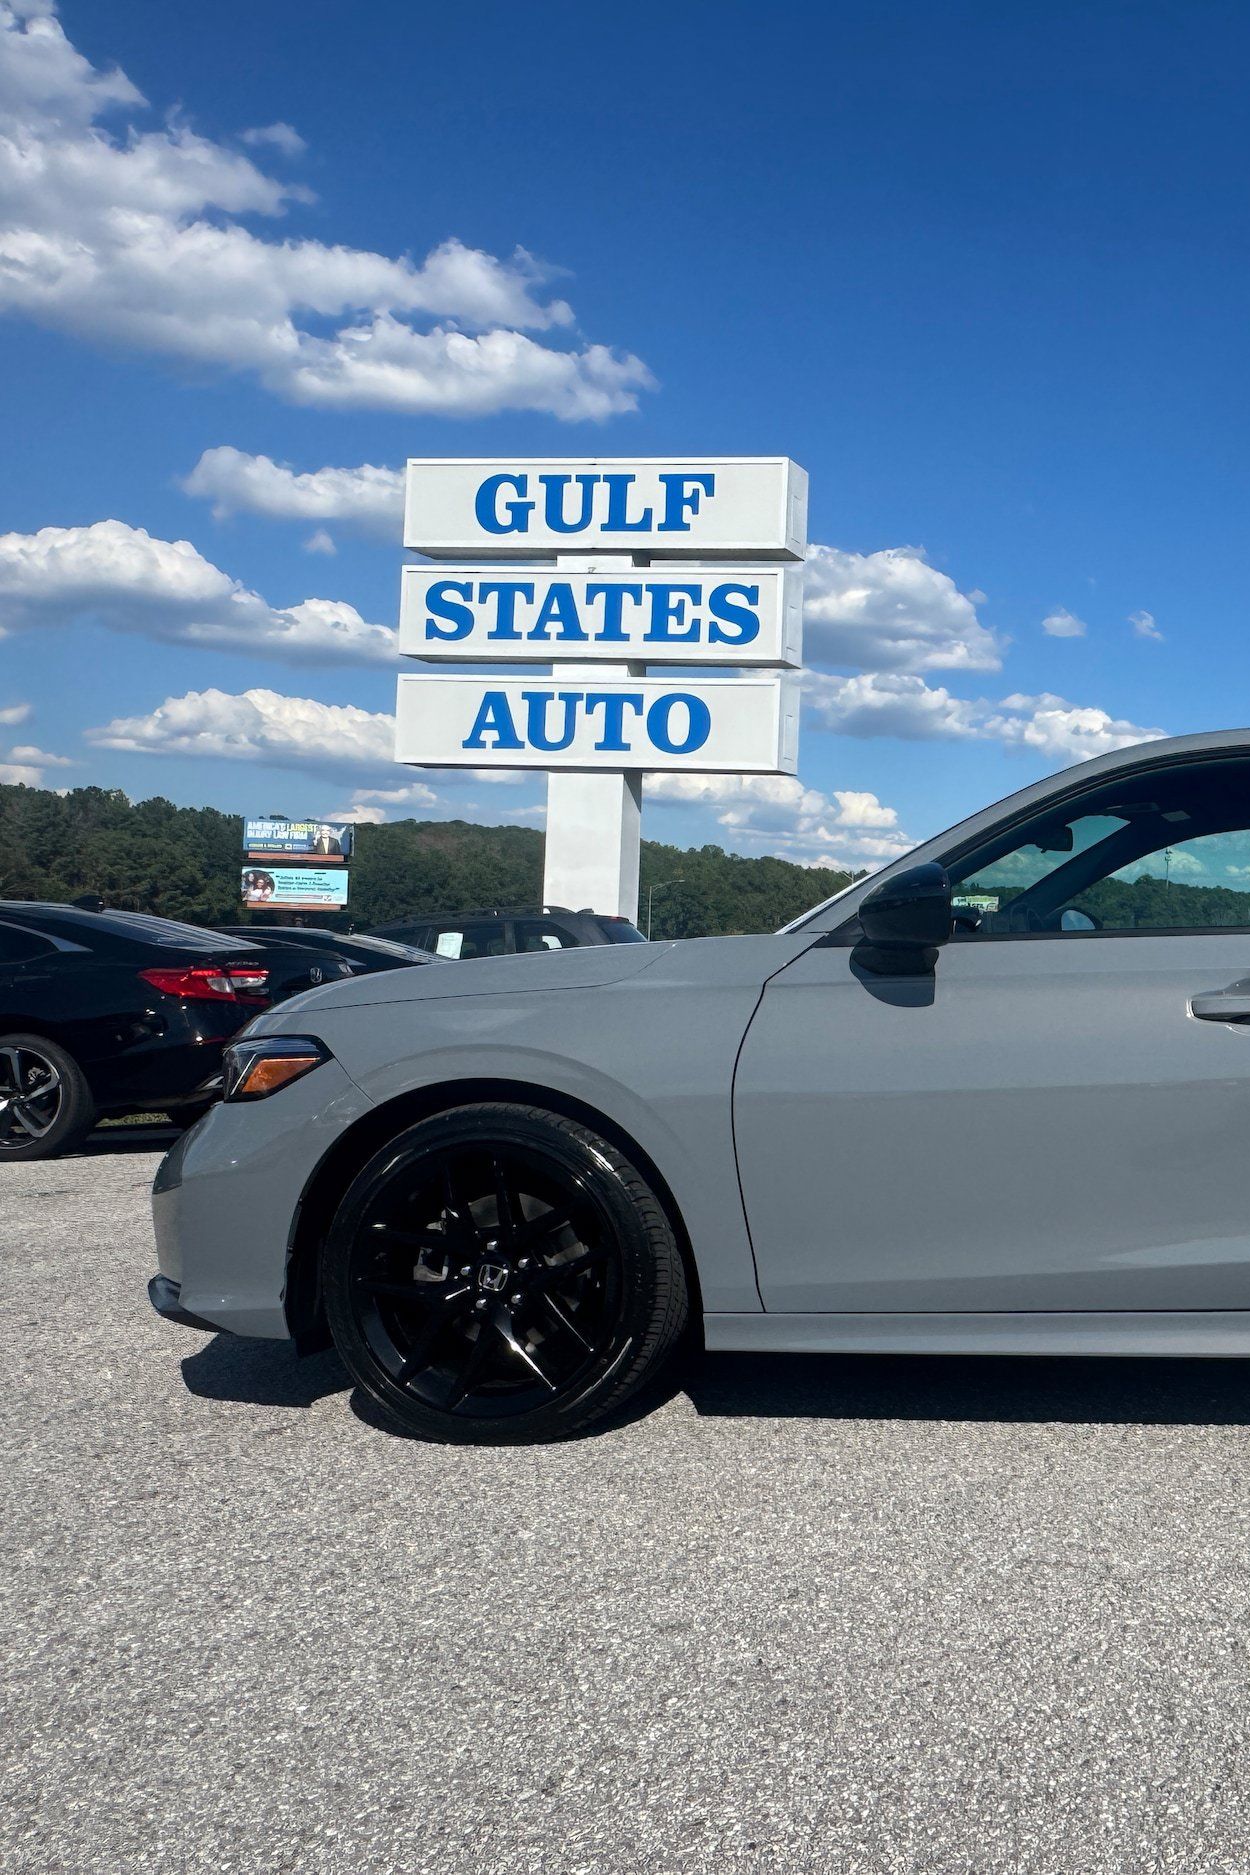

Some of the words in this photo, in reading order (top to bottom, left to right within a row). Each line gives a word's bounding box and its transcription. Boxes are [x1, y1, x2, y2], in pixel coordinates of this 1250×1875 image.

[475, 474, 715, 534] GULF
[425, 580, 760, 645] STATES
[462, 691, 711, 754] AUTO
[273, 831, 289, 839] LAW
[290, 831, 308, 840] FIRM
[287, 823, 317, 834] LARGEST
